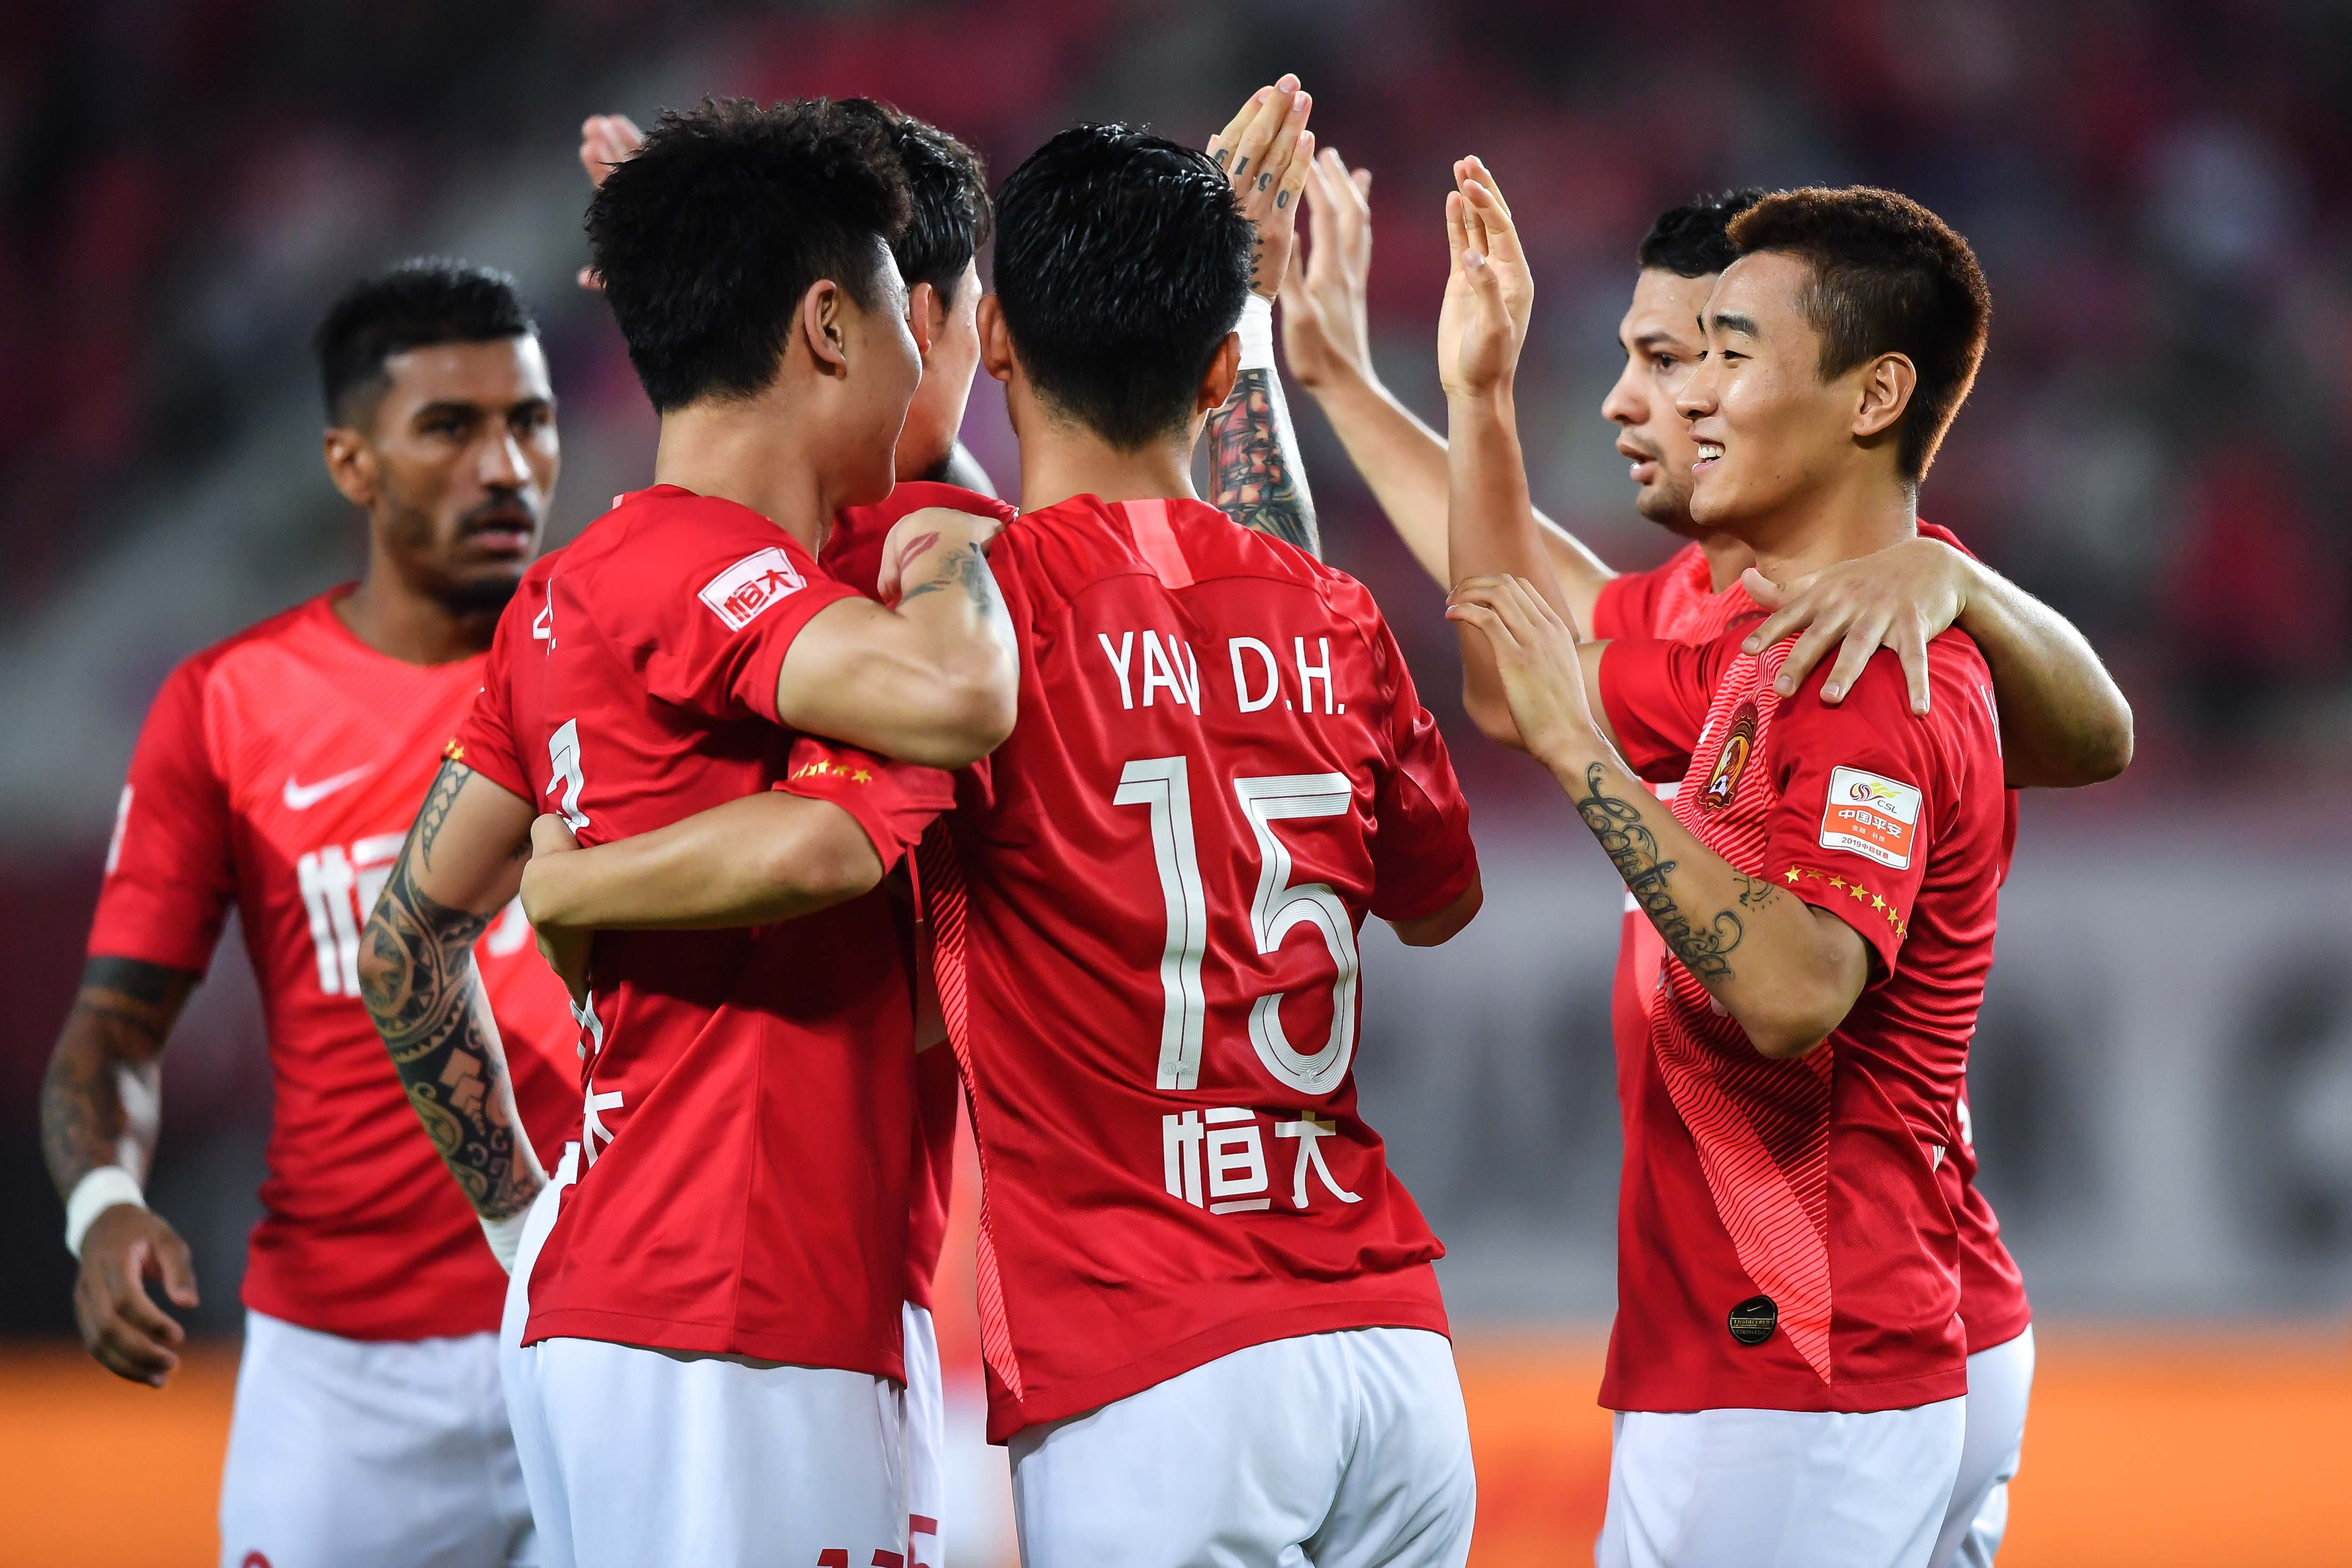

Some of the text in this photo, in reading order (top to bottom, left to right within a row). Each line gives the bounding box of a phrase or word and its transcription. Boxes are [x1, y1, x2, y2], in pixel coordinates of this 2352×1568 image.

[723, 569, 795, 622] 恒大
[1228, 636, 1345, 715] D.H.
[1837, 809, 1902, 839] 中国平安
[1877, 800, 1898, 814] CSL
[1112, 755, 1359, 1095] 15
[1162, 1106, 1363, 1215] 恒大
